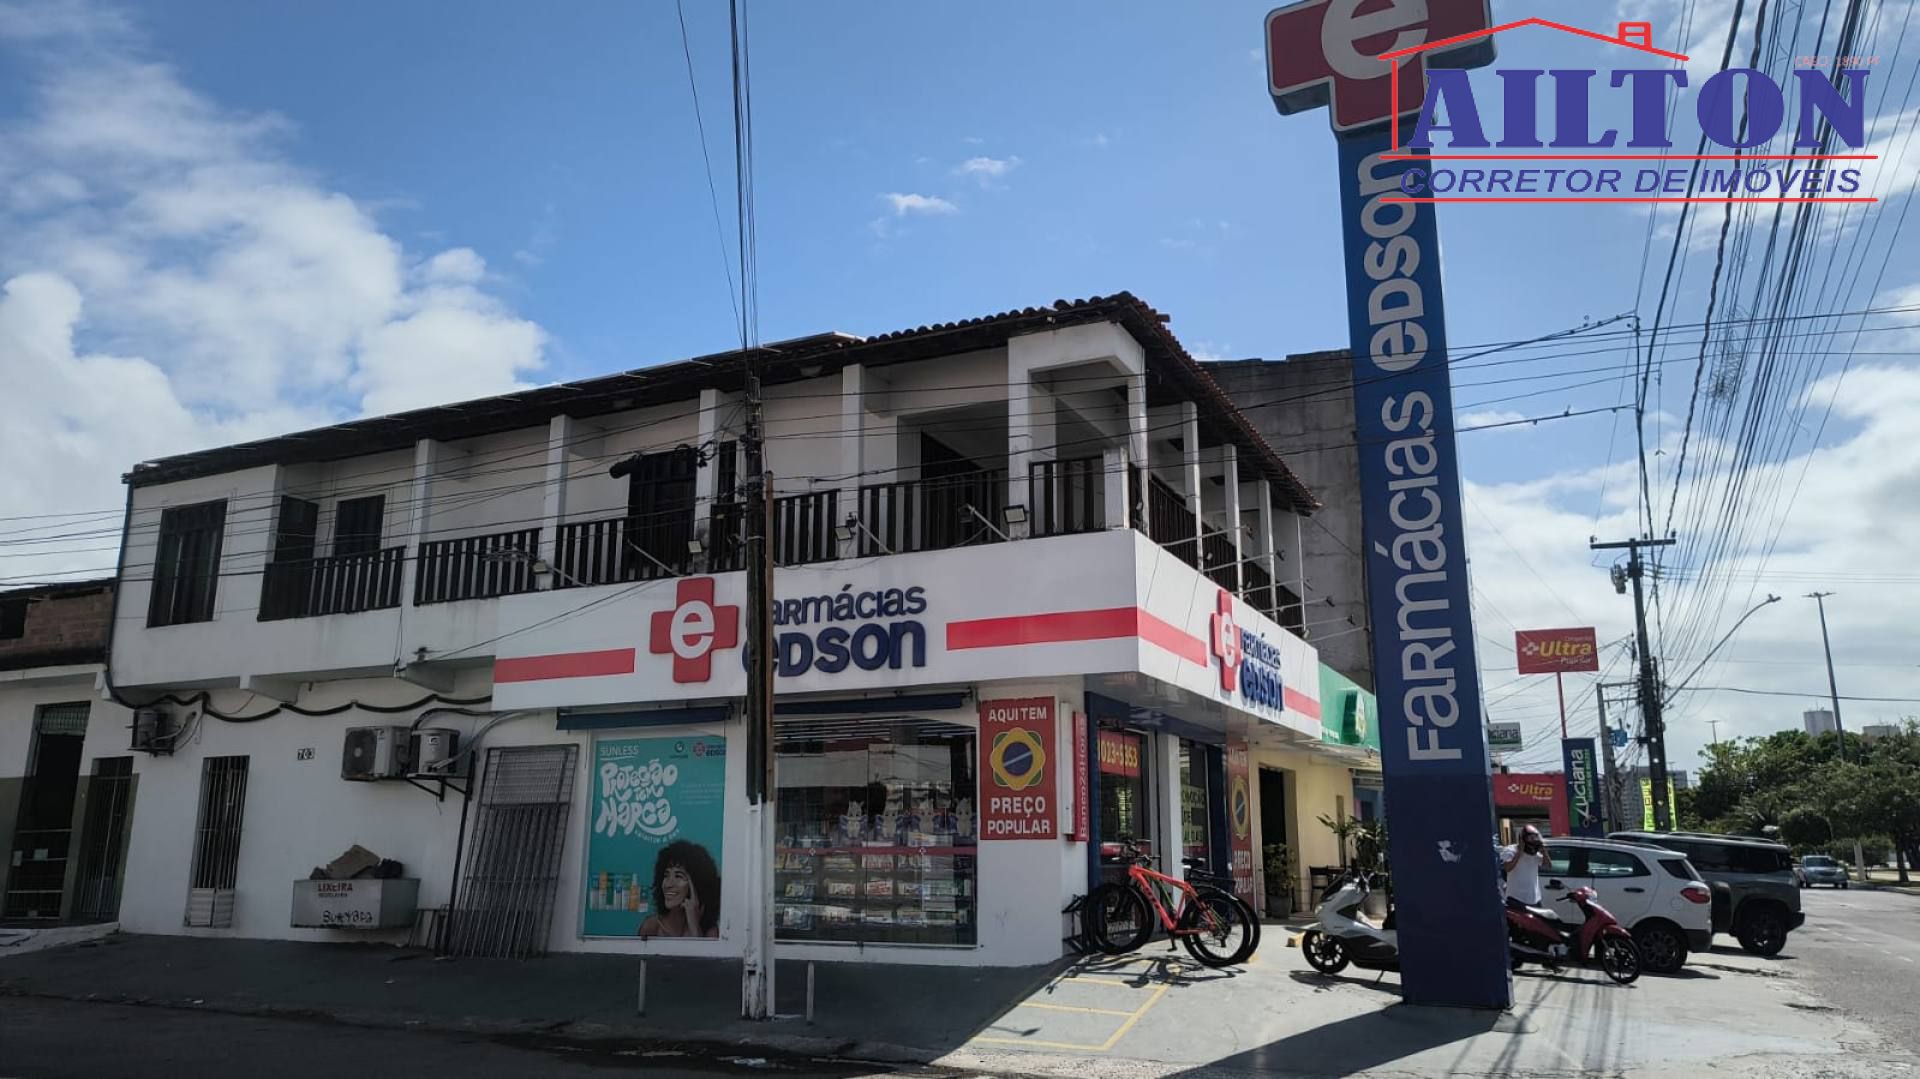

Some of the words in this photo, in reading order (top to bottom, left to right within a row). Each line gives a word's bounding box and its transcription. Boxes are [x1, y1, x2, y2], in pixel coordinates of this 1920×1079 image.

[1540, 640, 1592, 657] Ultra
[988, 708, 1018, 723] AQUI
[1019, 706, 1047, 720] TEM
[600, 745, 639, 756] SUNLESS
[1519, 783, 1553, 795] Ultra
[990, 796, 1046, 817] PREÇO
[987, 819, 1051, 835] POPULAR
